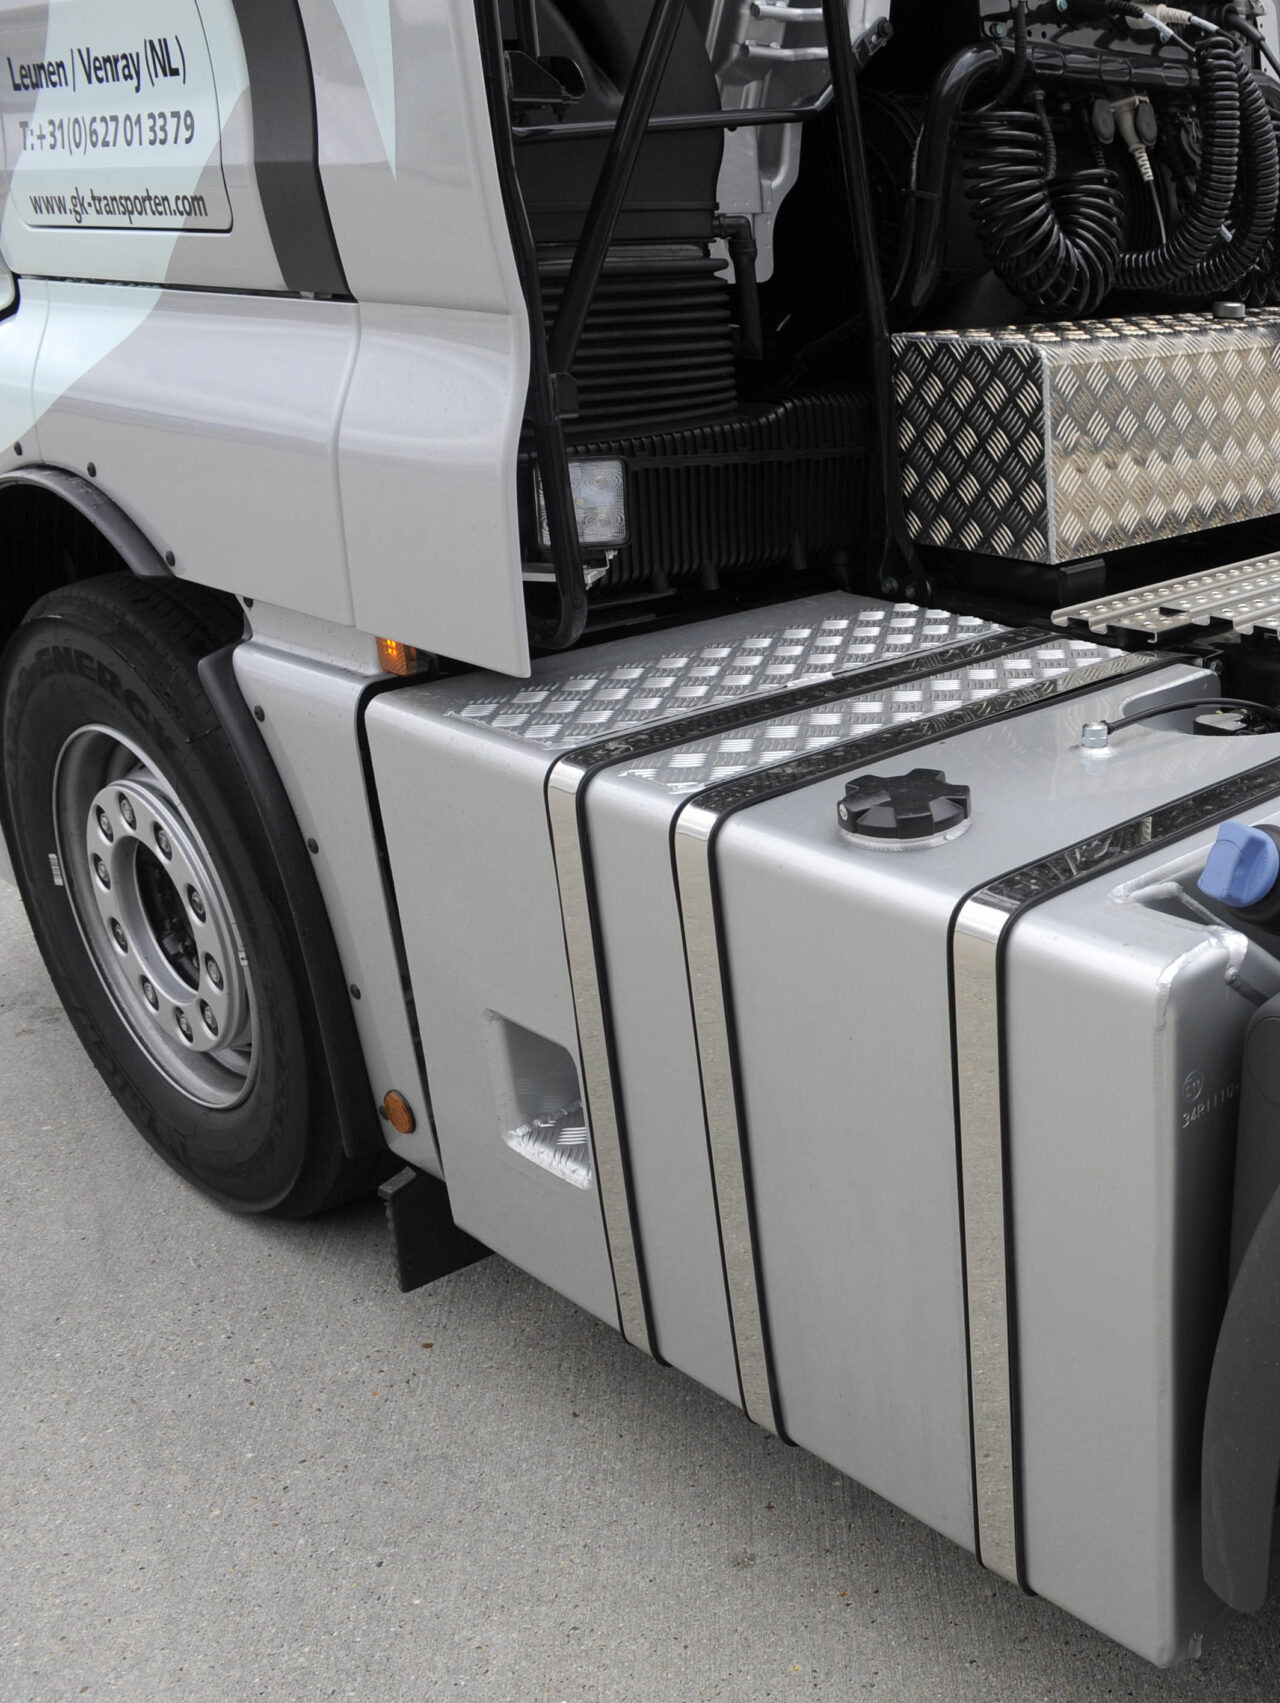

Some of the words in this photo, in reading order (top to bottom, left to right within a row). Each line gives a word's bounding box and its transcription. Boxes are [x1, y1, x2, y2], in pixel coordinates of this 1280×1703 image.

[7, 57, 69, 92] Leunen
[77, 47, 141, 94] Venray
[143, 34, 187, 87] (NL)
[29, 187, 209, 224] www.gk-transporten.com
